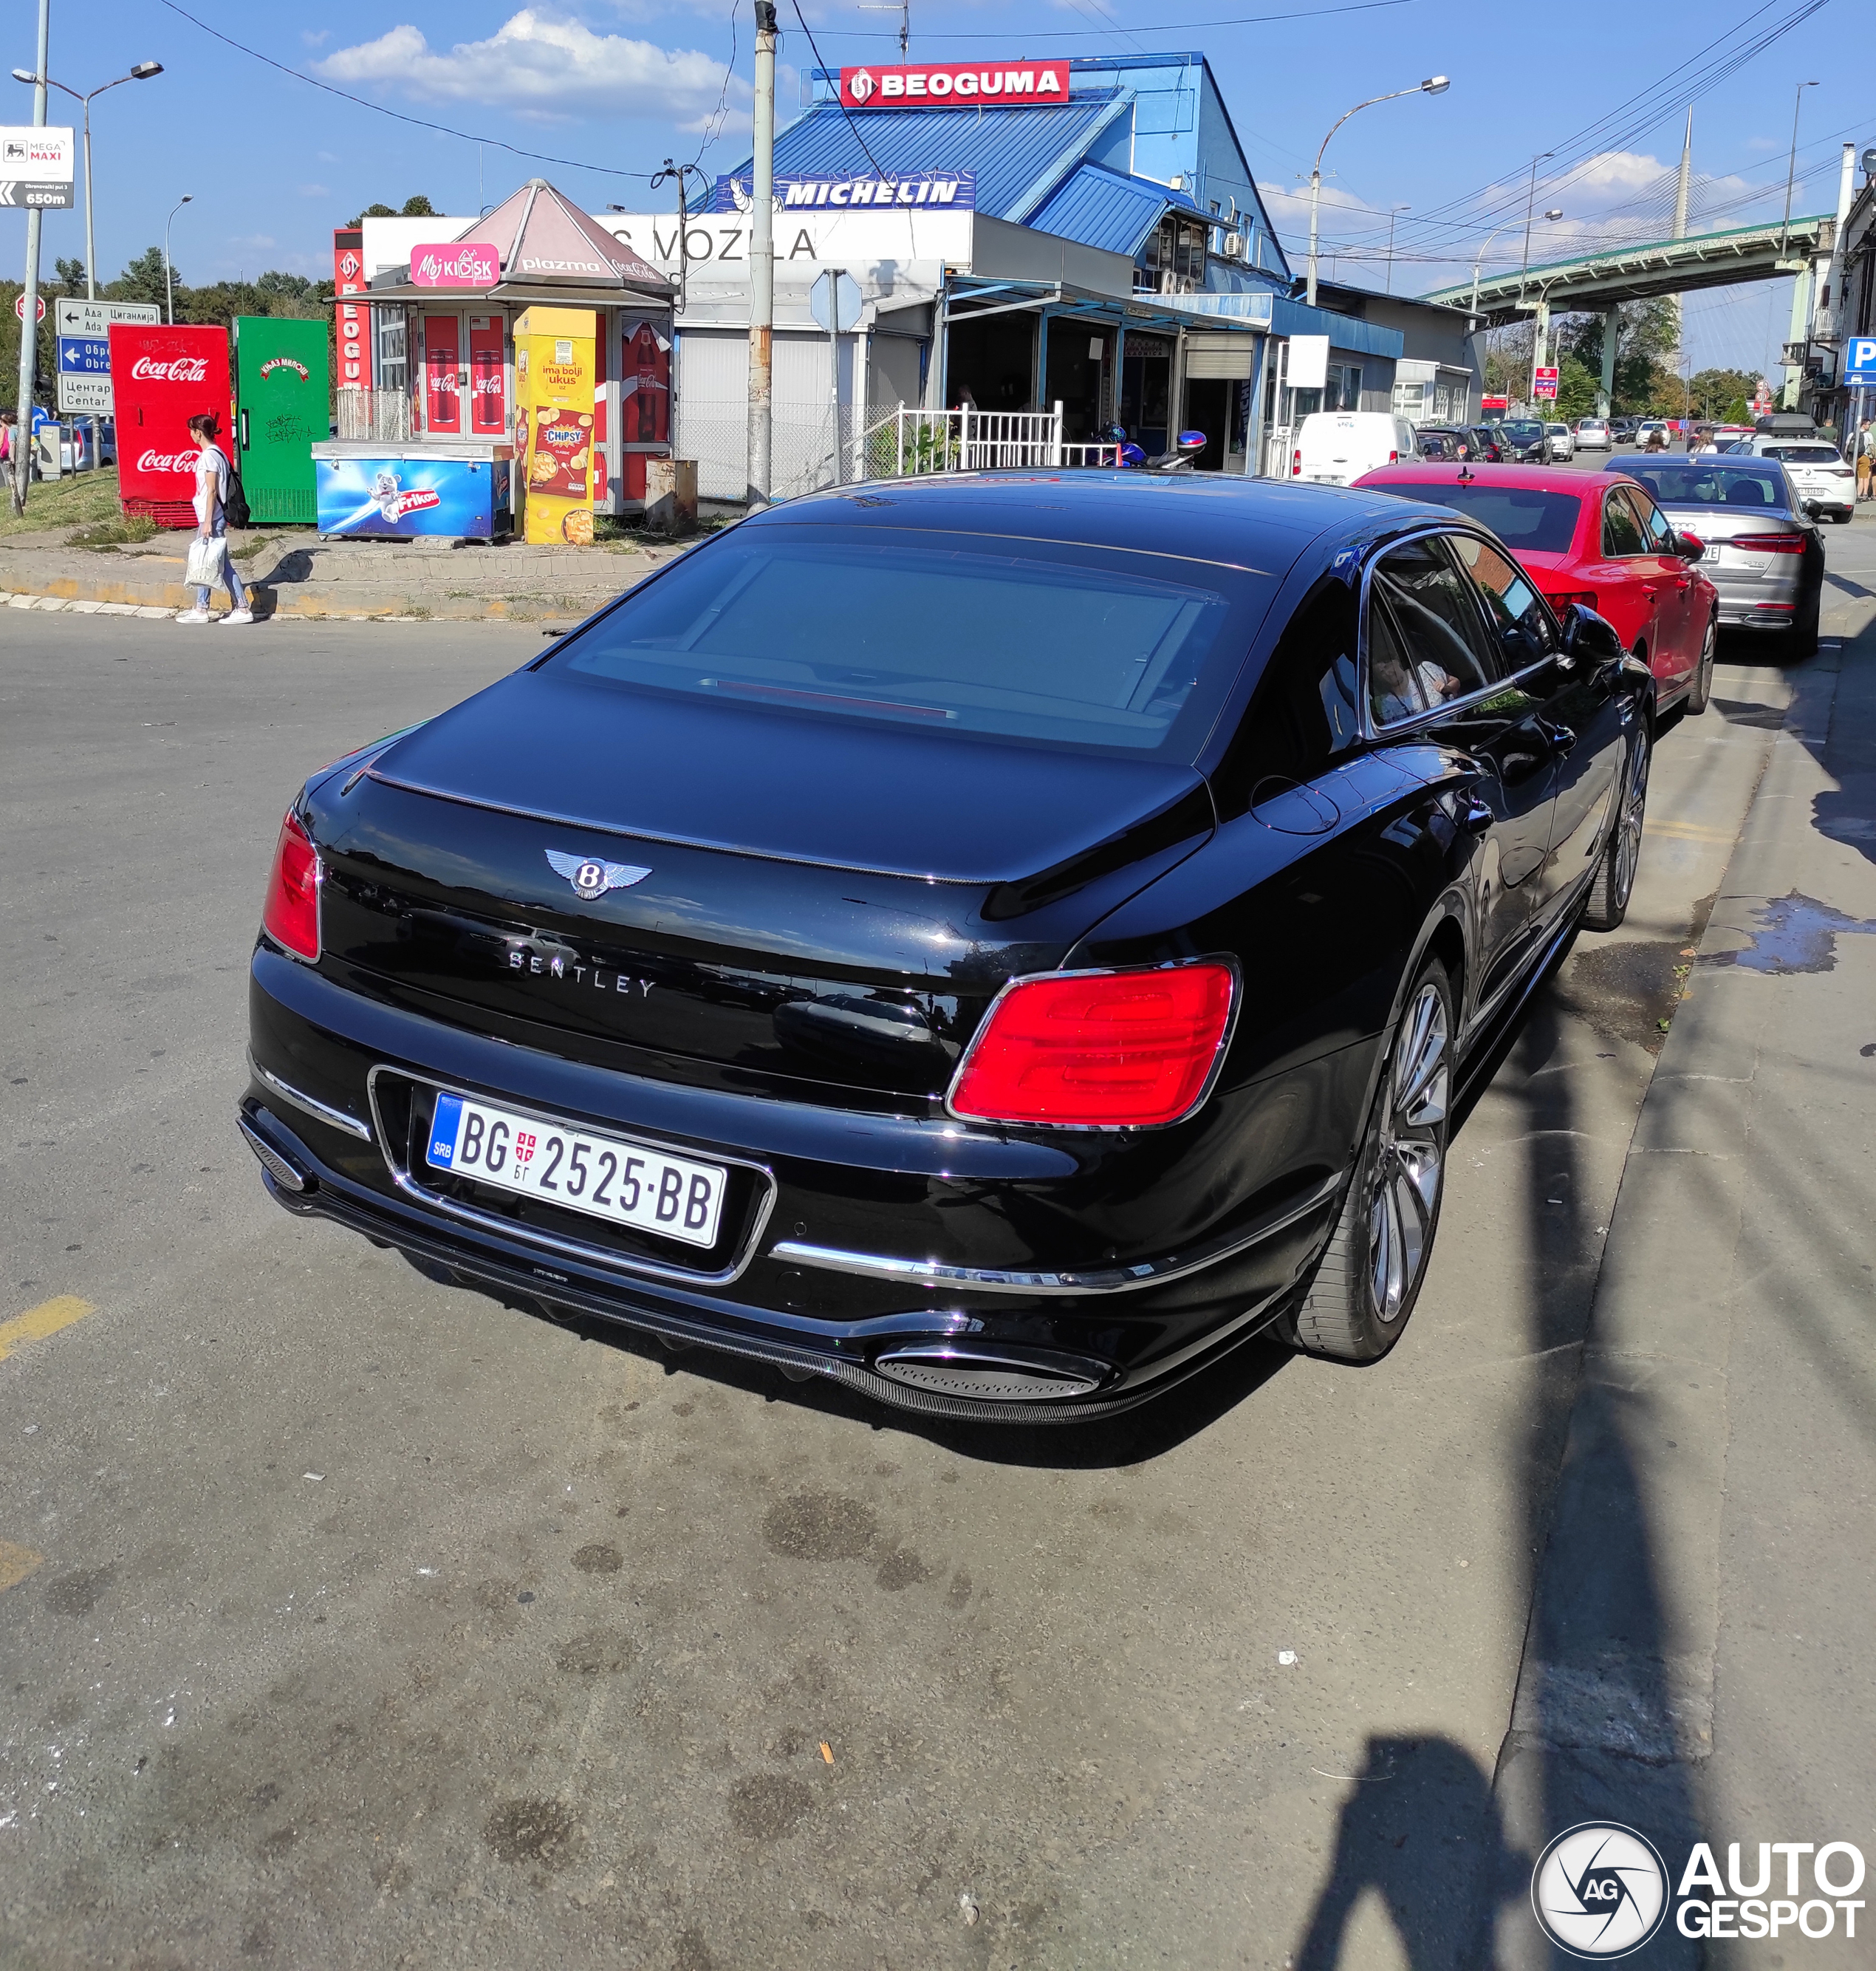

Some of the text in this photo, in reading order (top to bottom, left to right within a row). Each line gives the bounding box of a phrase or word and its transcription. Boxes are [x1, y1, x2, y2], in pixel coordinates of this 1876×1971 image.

[881, 70, 1061, 96] BEOGUMA
[30, 152, 61, 160] MAXI
[26, 194, 66, 205] 650m
[785, 181, 959, 205] MICHELIN
[654, 229, 818, 261] VOZA
[521, 256, 600, 272] plazma
[611, 259, 658, 280] Coca-Cola
[19, 302, 42, 314] SP
[84, 307, 154, 323] Ада Циганлија
[84, 321, 102, 331] Ada
[1855, 341, 1876, 368] P
[131, 357, 209, 382] Coca-Cola
[260, 359, 309, 375] КЊАЗ МИЛОШ
[543, 366, 582, 377] ima bolji
[66, 381, 110, 394] Центар
[550, 375, 576, 384] ukus
[66, 395, 106, 406] Centar
[137, 448, 203, 474] Coca-Co
[398, 492, 439, 511] Frikom
[510, 952, 657, 998] BENTLEY
[434, 1141, 452, 1158] SRB
[460, 1111, 510, 1172] BG
